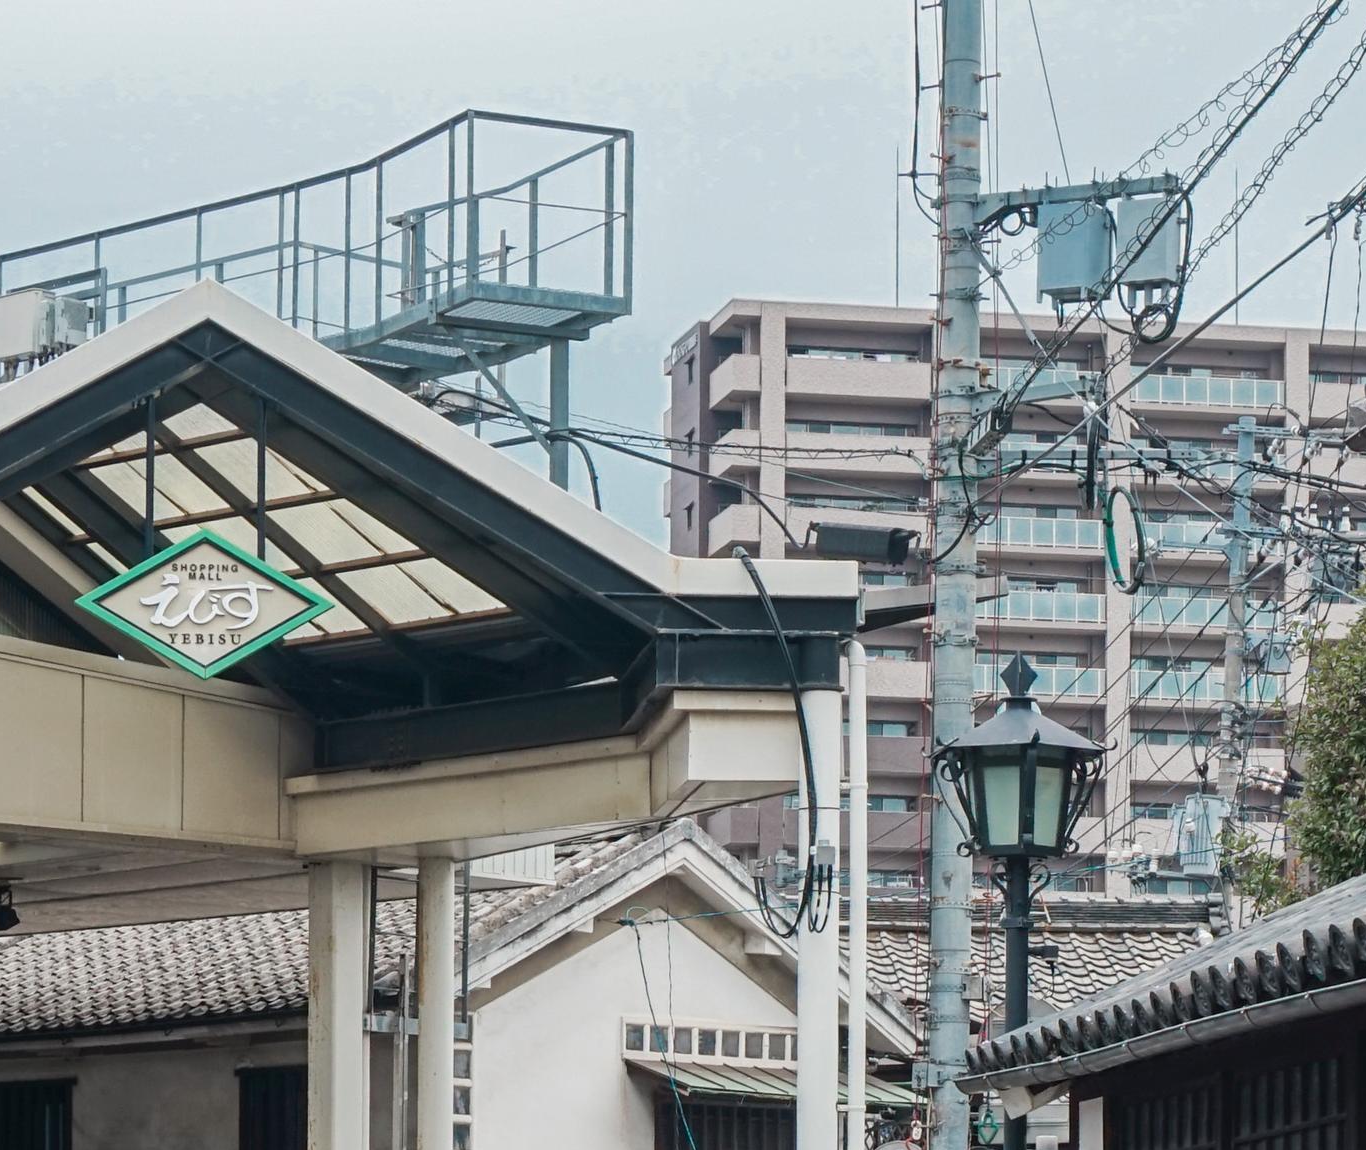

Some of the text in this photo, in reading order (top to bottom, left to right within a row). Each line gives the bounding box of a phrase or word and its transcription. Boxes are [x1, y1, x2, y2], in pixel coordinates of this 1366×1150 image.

[171, 562, 239, 574] SHOPPING
[188, 571, 223, 581] MALL
[168, 633, 243, 646] YEBISU
